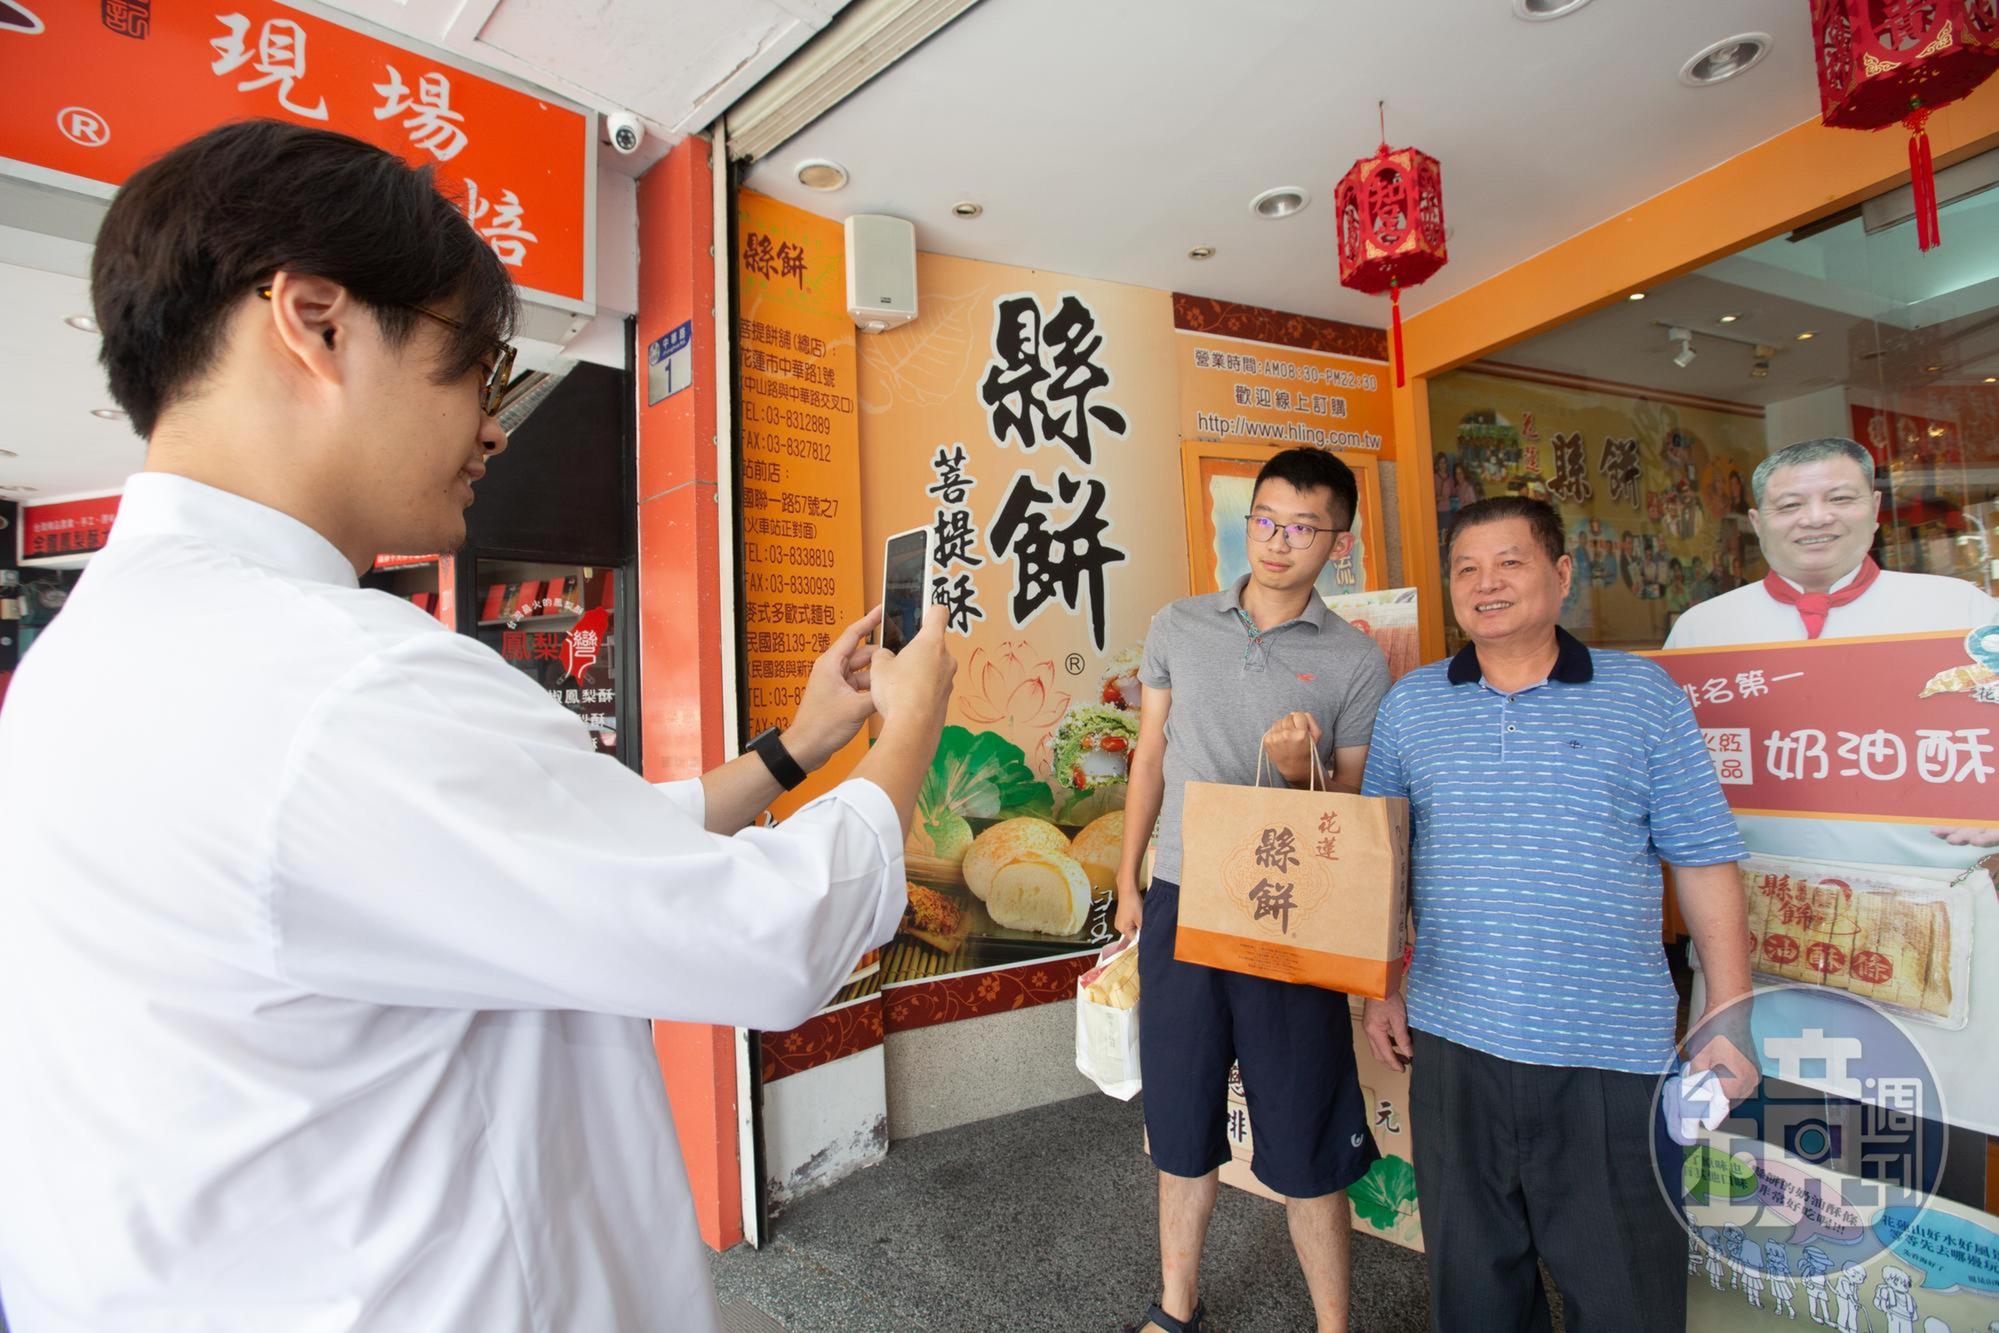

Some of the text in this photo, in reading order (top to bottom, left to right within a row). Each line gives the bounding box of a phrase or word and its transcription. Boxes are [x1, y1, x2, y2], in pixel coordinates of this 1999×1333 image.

[210, 13, 469, 161] 現場
[743, 233, 808, 290] 縣餅
[1235, 384, 1346, 417] 歡迎線上訂購
[1197, 413, 1381, 451] http://www.hling.com.tw
[983, 296, 1128, 651] 縣餅
[1763, 728, 1998, 784] 奶油酥
[1315, 811, 1341, 861] 花蓮
[1249, 827, 1301, 935] 縣餅
